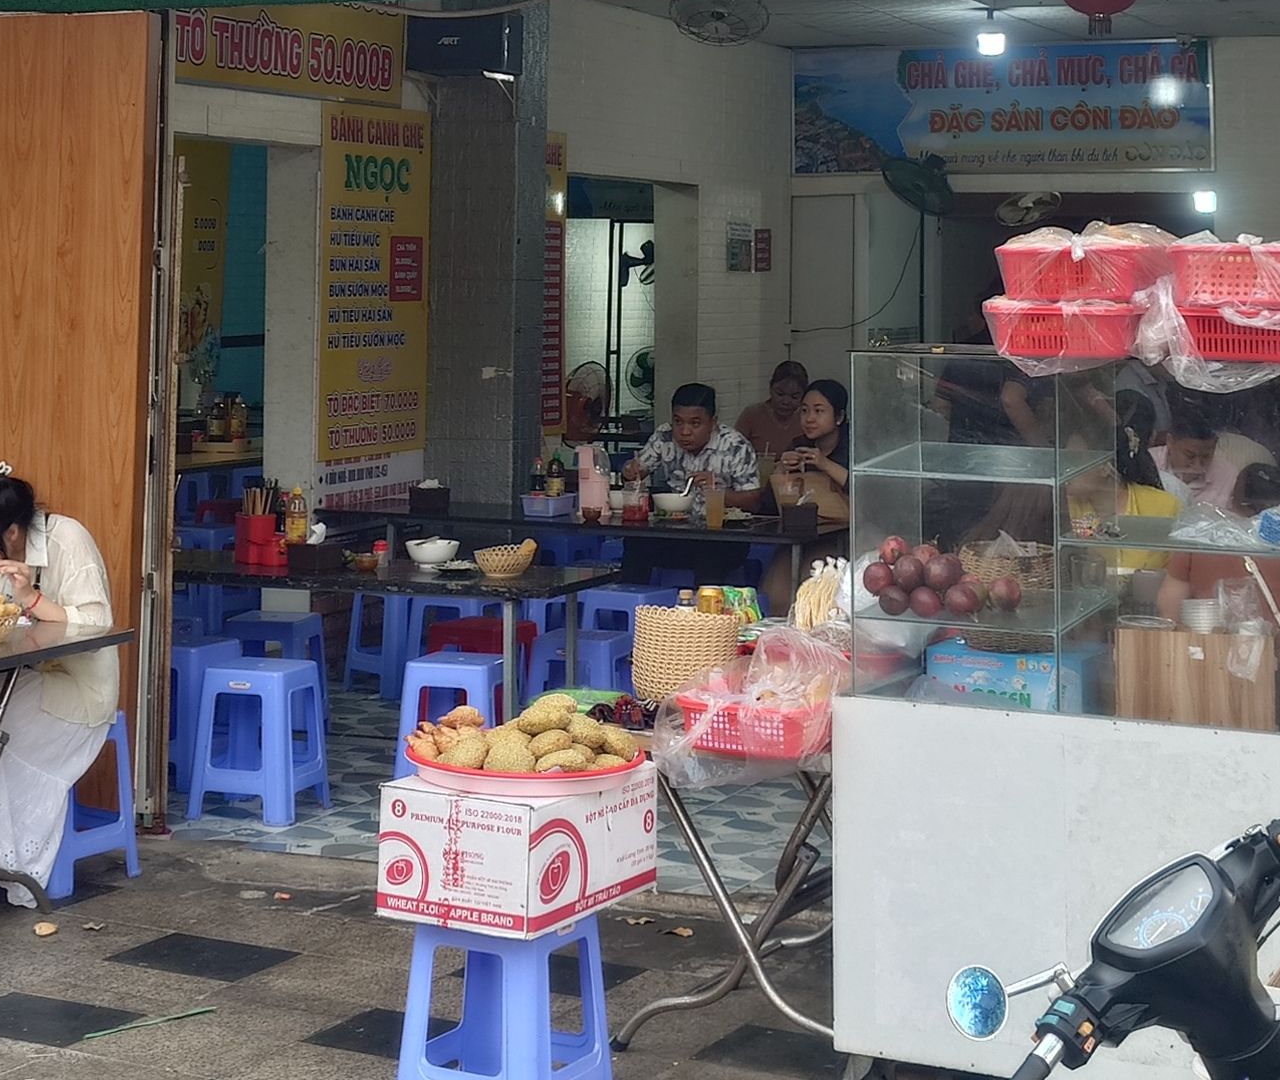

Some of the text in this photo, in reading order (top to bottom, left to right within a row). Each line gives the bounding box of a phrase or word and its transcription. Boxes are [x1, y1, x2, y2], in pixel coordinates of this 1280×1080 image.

[175, 7, 394, 91] TÔ THƯỜNG 50.000Đ
[906, 51, 948, 89] CHẢ
[1007, 48, 1050, 88] CHẢ
[1057, 55, 1112, 92] MỰC,
[1119, 47, 1161, 84] CHẢ
[1170, 48, 1201, 84] CÁ
[331, 110, 424, 154] BÁNH CANH GHẸ
[929, 97, 1180, 139] ĐẶC SẢN CÔN ĐẢO
[344, 153, 411, 204] NGỌC
[394, 800, 403, 816] 8
[410, 812, 444, 825] PREMIUM
[461, 820, 495, 833] PURPOSE
[496, 825, 522, 836] FLOUR
[464, 808, 480, 818] ISO
[645, 811, 653, 831] 8
[387, 897, 417, 911] WHEAT
[449, 908, 479, 921] APPLE
[481, 912, 513, 927] BRAND
